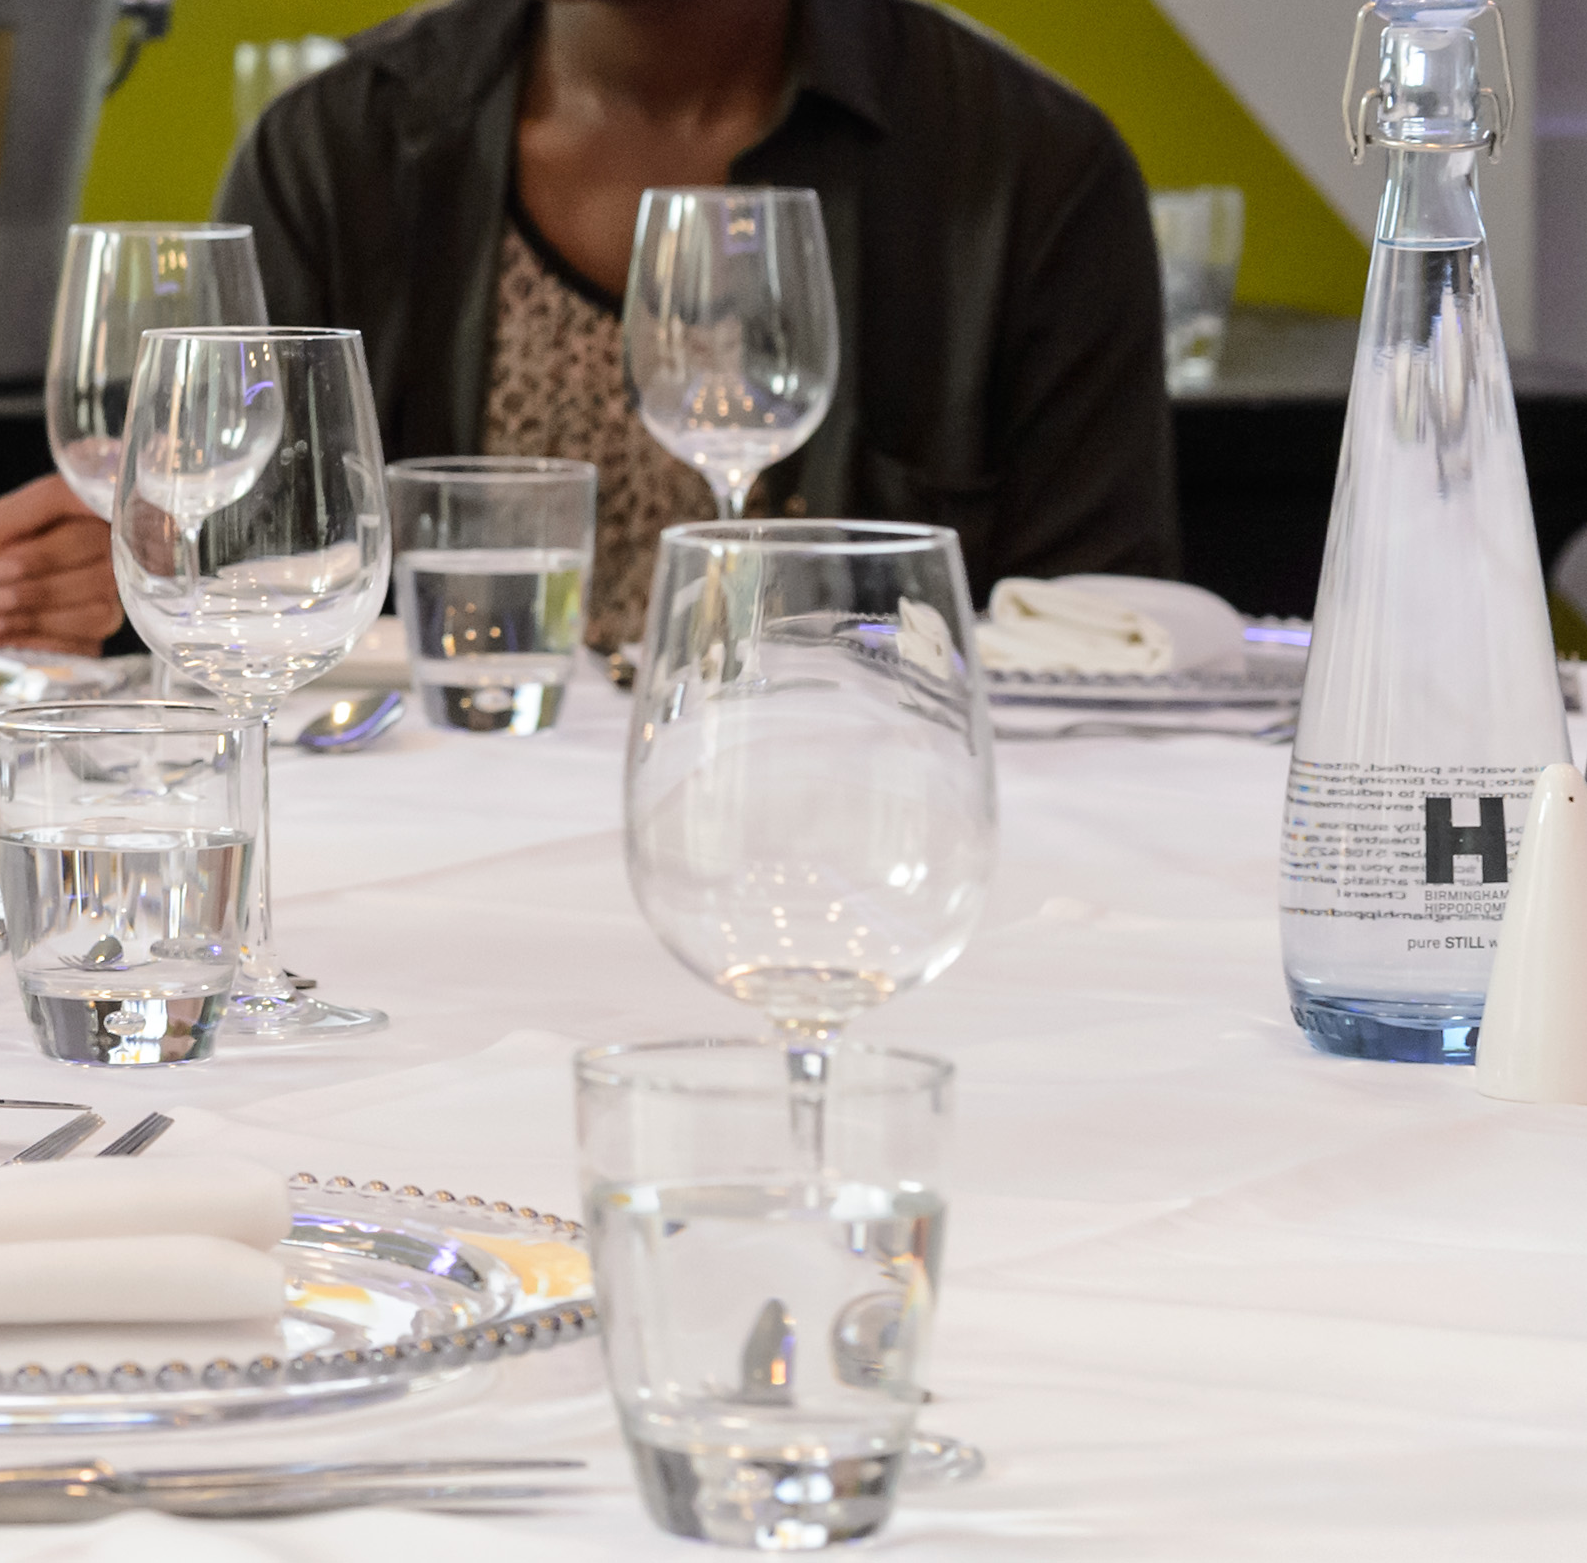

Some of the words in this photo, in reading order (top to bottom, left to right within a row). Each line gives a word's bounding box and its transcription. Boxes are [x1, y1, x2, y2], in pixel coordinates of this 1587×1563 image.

[1425, 797, 1508, 884] H
[1407, 938, 1441, 951] pure
[1445, 937, 1485, 949] STILL
